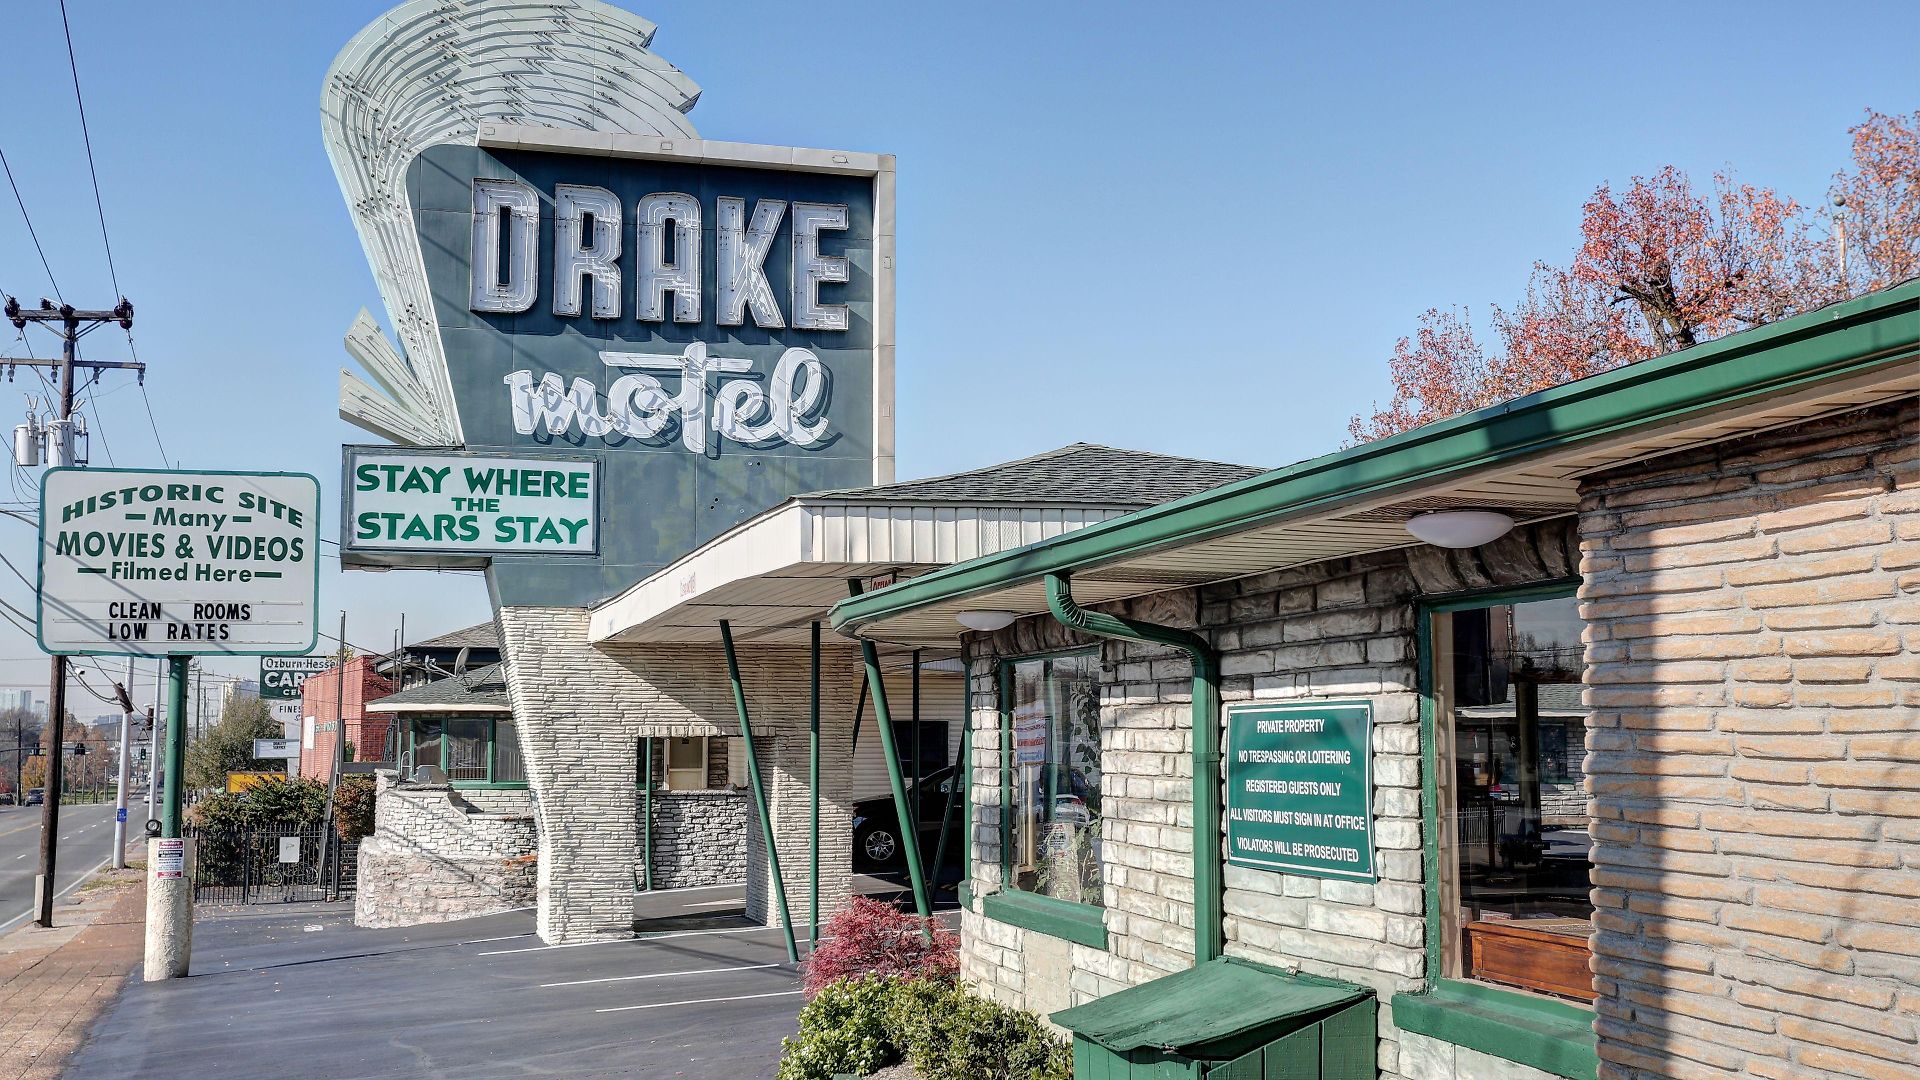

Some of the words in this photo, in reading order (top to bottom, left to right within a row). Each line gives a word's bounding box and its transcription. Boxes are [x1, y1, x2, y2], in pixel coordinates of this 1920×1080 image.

[469, 177, 850, 332] DRAKE
[503, 341, 829, 454] motel
[356, 463, 451, 494] STAY
[463, 467, 590, 499] WHERE
[62, 484, 224, 524] HISTORIC
[238, 491, 304, 529] SITE
[451, 497, 500, 513] THE
[152, 507, 227, 532] Many
[357, 512, 480, 542] STARS
[494, 516, 589, 545] STAY
[55, 531, 165, 558] MOVIES
[175, 534, 195, 559] &
[206, 535, 304, 562] VIDEOS
[112, 562, 188, 581] Filmed
[195, 564, 252, 582] Here
[108, 602, 162, 620] CLEAN
[193, 603, 251, 621] ROOMS
[108, 623, 147, 640] LOW
[167, 624, 230, 640] RATES
[264, 671, 317, 688] CAR
[1257, 720, 1284, 733] PRIVATE
[1285, 719, 1325, 733] PROPERTY
[1238, 750, 1248, 763] NO
[1248, 750, 1294, 764] TRESPASSING
[1295, 751, 1307, 764] OR
[1307, 751, 1351, 764] LOITERING
[1245, 779, 1288, 794] REGISTERED
[1288, 781, 1318, 796] GUESTS
[1320, 782, 1341, 797] ONLY
[1230, 808, 1243, 821] ALL
[1243, 809, 1272, 823] VISITORS
[1273, 811, 1293, 825] MUST
[1294, 812, 1313, 827] SIGN
[1313, 813, 1322, 828] IN
[1323, 814, 1333, 828] AT
[1334, 815, 1366, 831] OFFICE
[1236, 837, 1273, 853] VIOLATORS
[1274, 840, 1291, 855] WILL
[1292, 843, 1303, 857] BE
[1304, 844, 1359, 863] PROSECUTED
